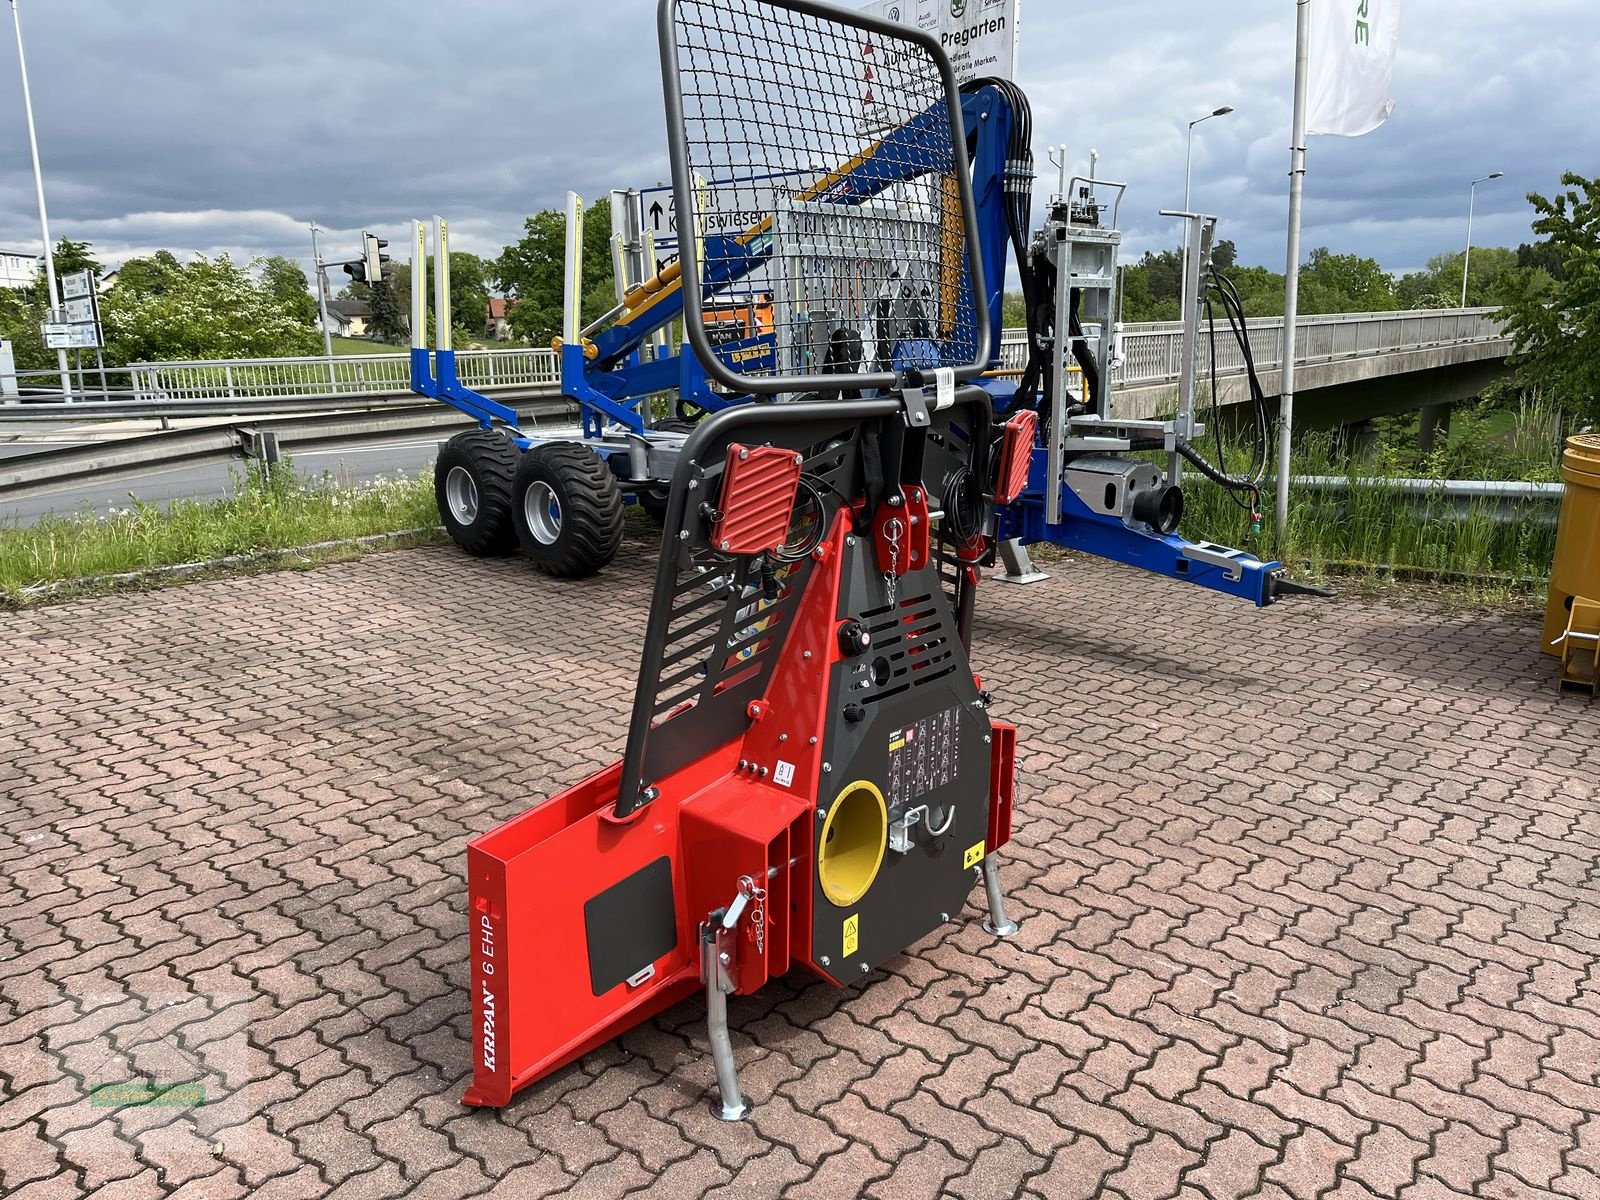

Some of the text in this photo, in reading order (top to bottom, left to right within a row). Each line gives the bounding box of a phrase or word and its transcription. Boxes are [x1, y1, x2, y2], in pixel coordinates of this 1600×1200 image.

[941, 16, 1005, 47] Pregarten
[669, 208, 768, 233] Kswiesen
[712, 332, 732, 340] MAN
[481, 915, 494, 957] EHP
[482, 961, 495, 976] 6
